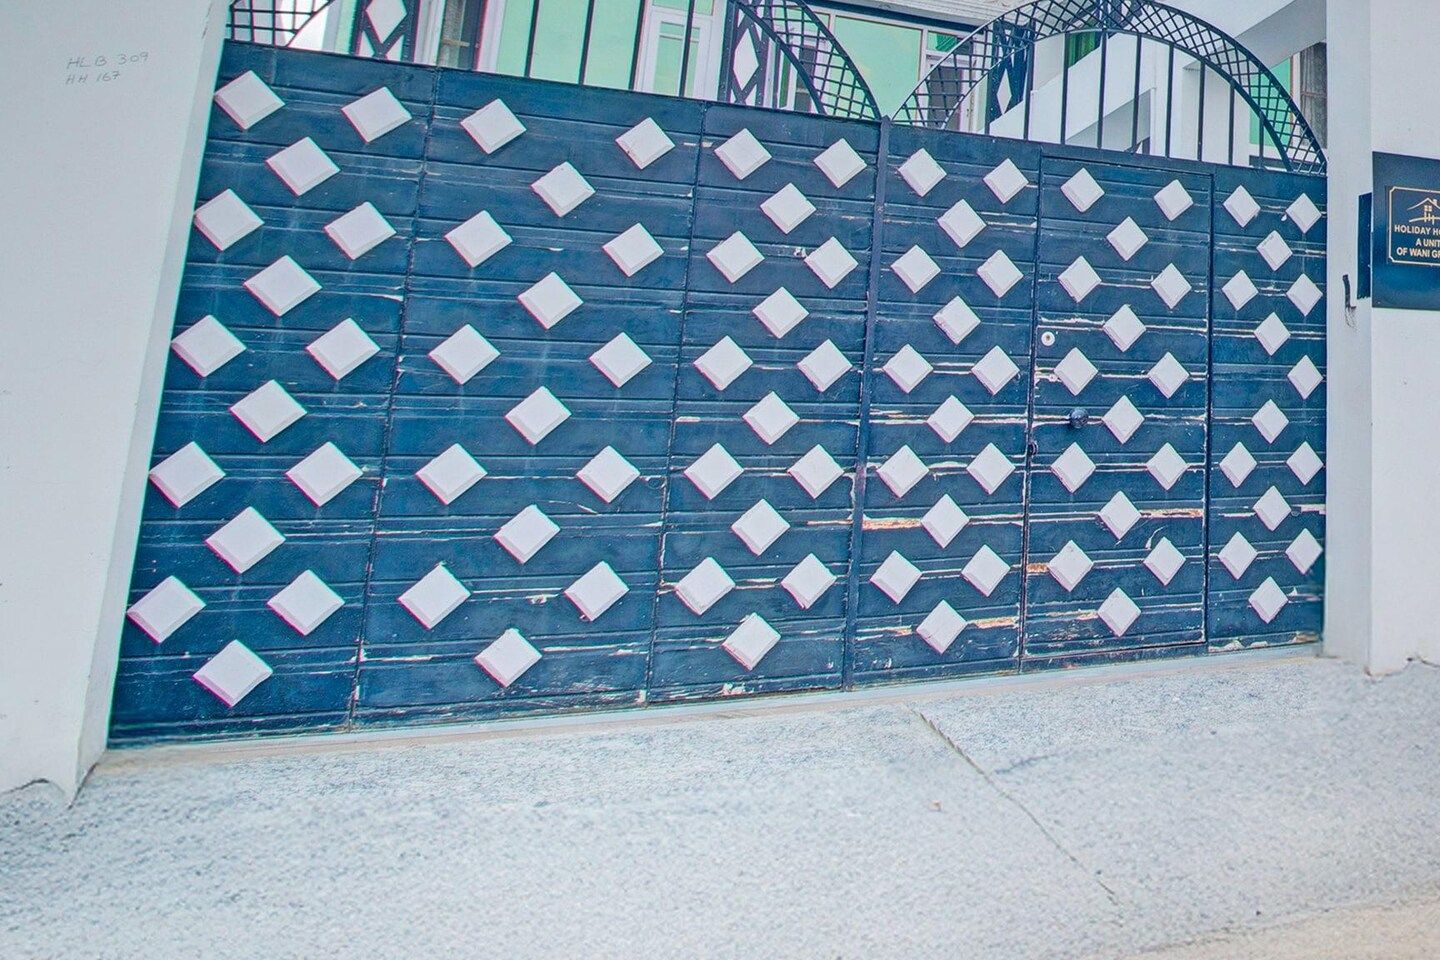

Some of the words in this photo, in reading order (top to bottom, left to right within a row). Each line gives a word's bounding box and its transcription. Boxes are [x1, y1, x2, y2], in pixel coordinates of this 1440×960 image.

[118, 51, 149, 65] 309
[96, 70, 121, 82] 167
[1394, 224, 1431, 235] HOLIDAY
[1415, 238, 1422, 246] A
[1423, 239, 1440, 248] UNIT
[1396, 247, 1408, 256] OF
[1409, 248, 1430, 257] WANI
